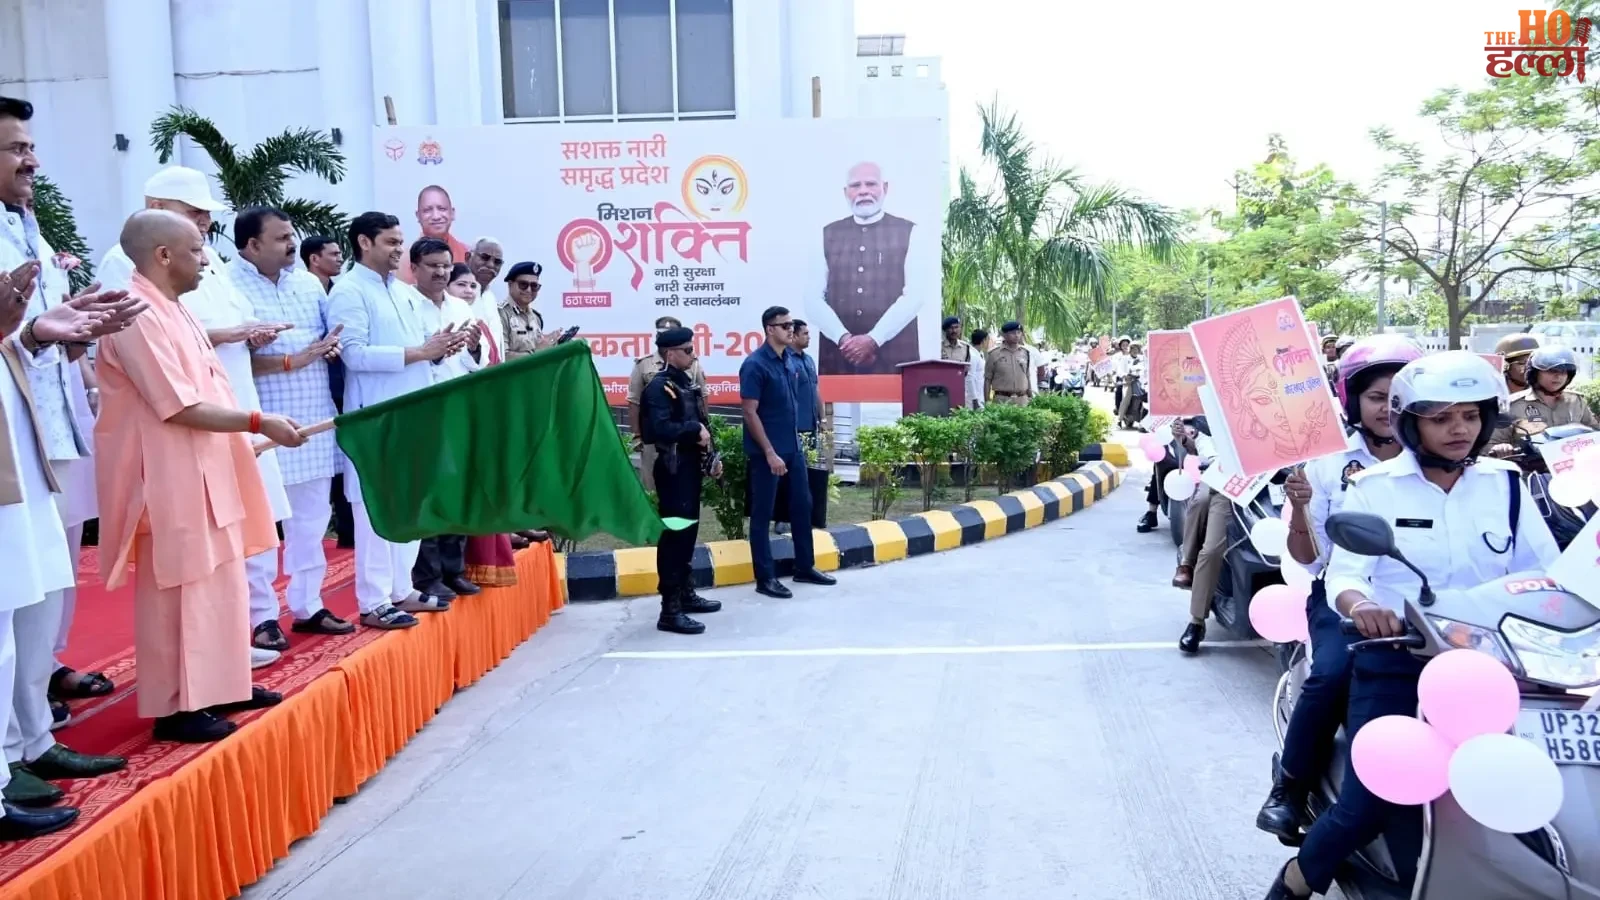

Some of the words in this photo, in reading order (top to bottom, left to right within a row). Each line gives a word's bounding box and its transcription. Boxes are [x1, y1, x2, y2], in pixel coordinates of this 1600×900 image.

[561, 141, 622, 160] सशक्त
[626, 133, 667, 158] नारी
[560, 167, 615, 192] समृद्ध
[619, 160, 670, 185] प्रदेश
[597, 203, 653, 221] मिशन
[613, 201, 752, 291] शक्ति
[654, 264, 679, 277] नारी
[682, 267, 716, 281] सुरक्षा
[654, 279, 679, 292] नारी
[682, 282, 724, 292] सम्मान
[584, 295, 608, 306] चरण
[654, 294, 679, 306] नारी
[1506, 579, 1565, 594] POL
[1540, 712, 1600, 736] UP32
